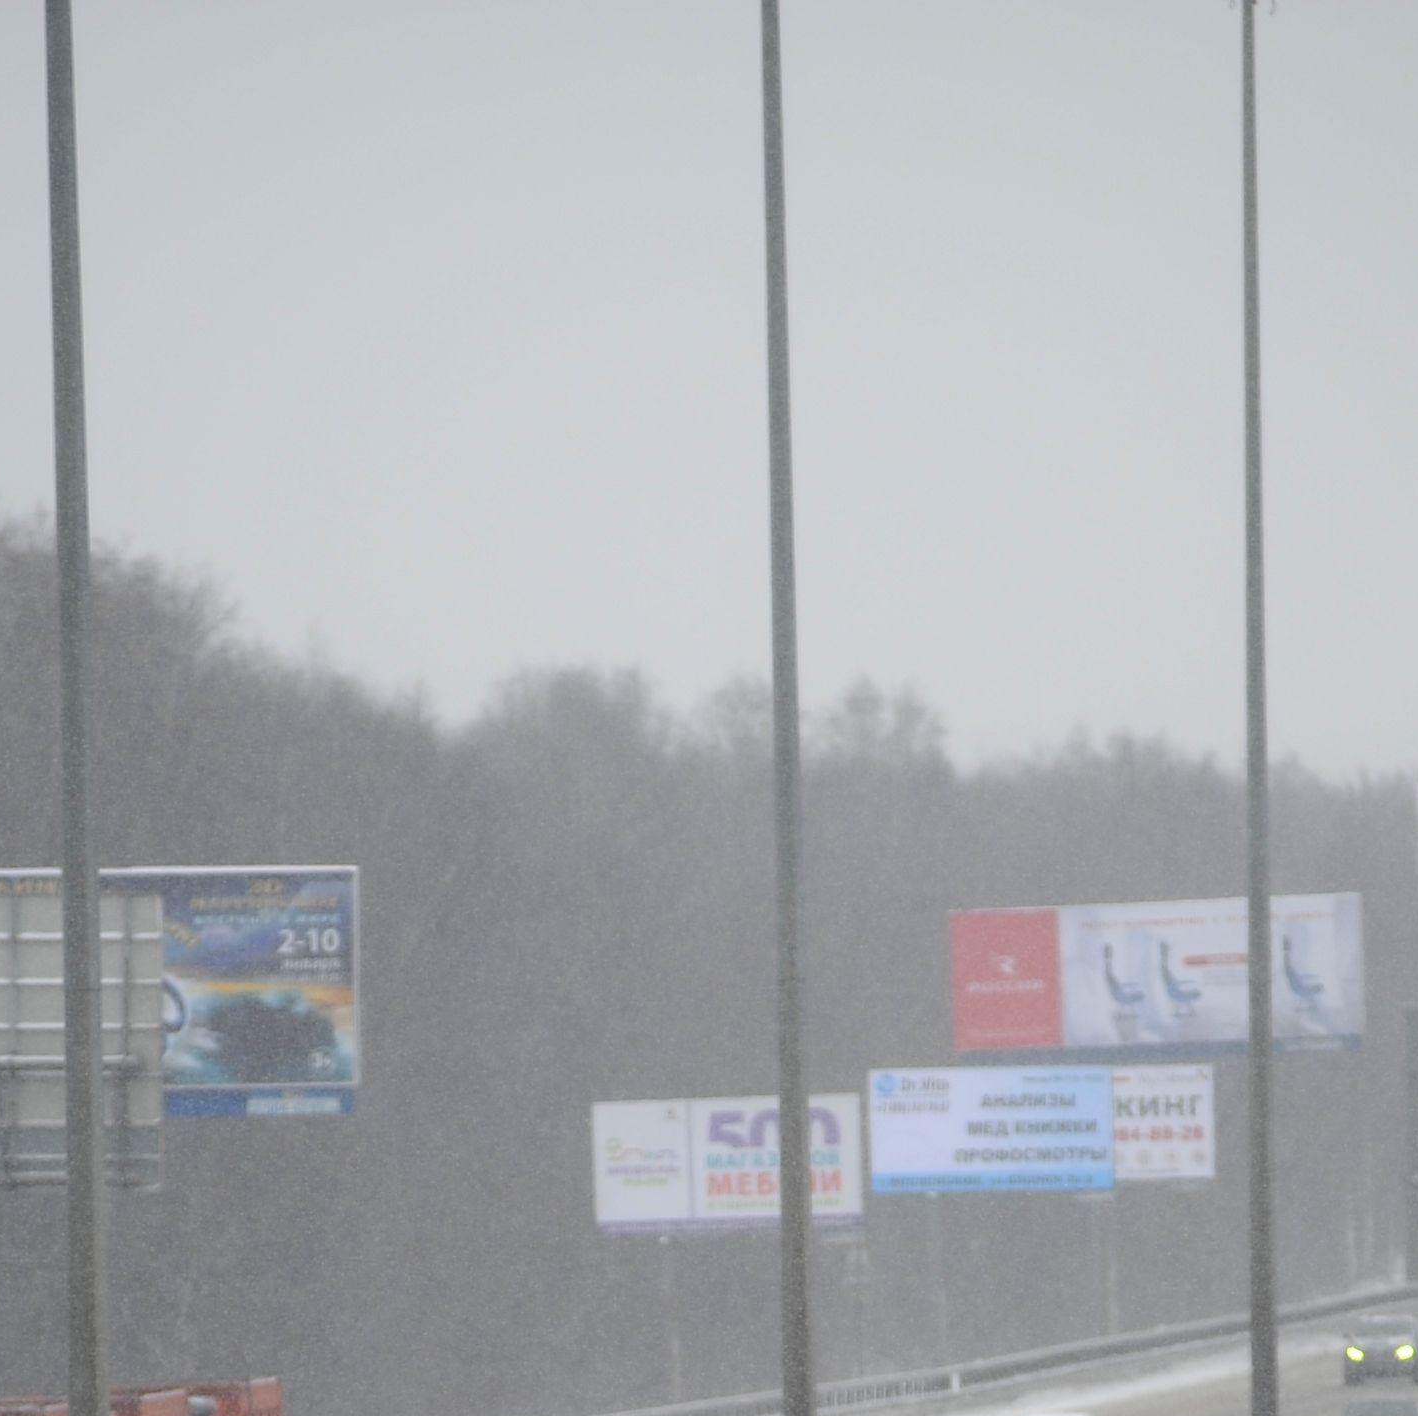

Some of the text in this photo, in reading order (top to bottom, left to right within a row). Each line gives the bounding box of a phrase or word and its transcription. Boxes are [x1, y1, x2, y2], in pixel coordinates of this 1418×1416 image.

[278, 927, 341, 953] 2-10
[707, 1151, 840, 1169] МАГАЗОВ
[707, 1170, 842, 1196] МЕБИ
